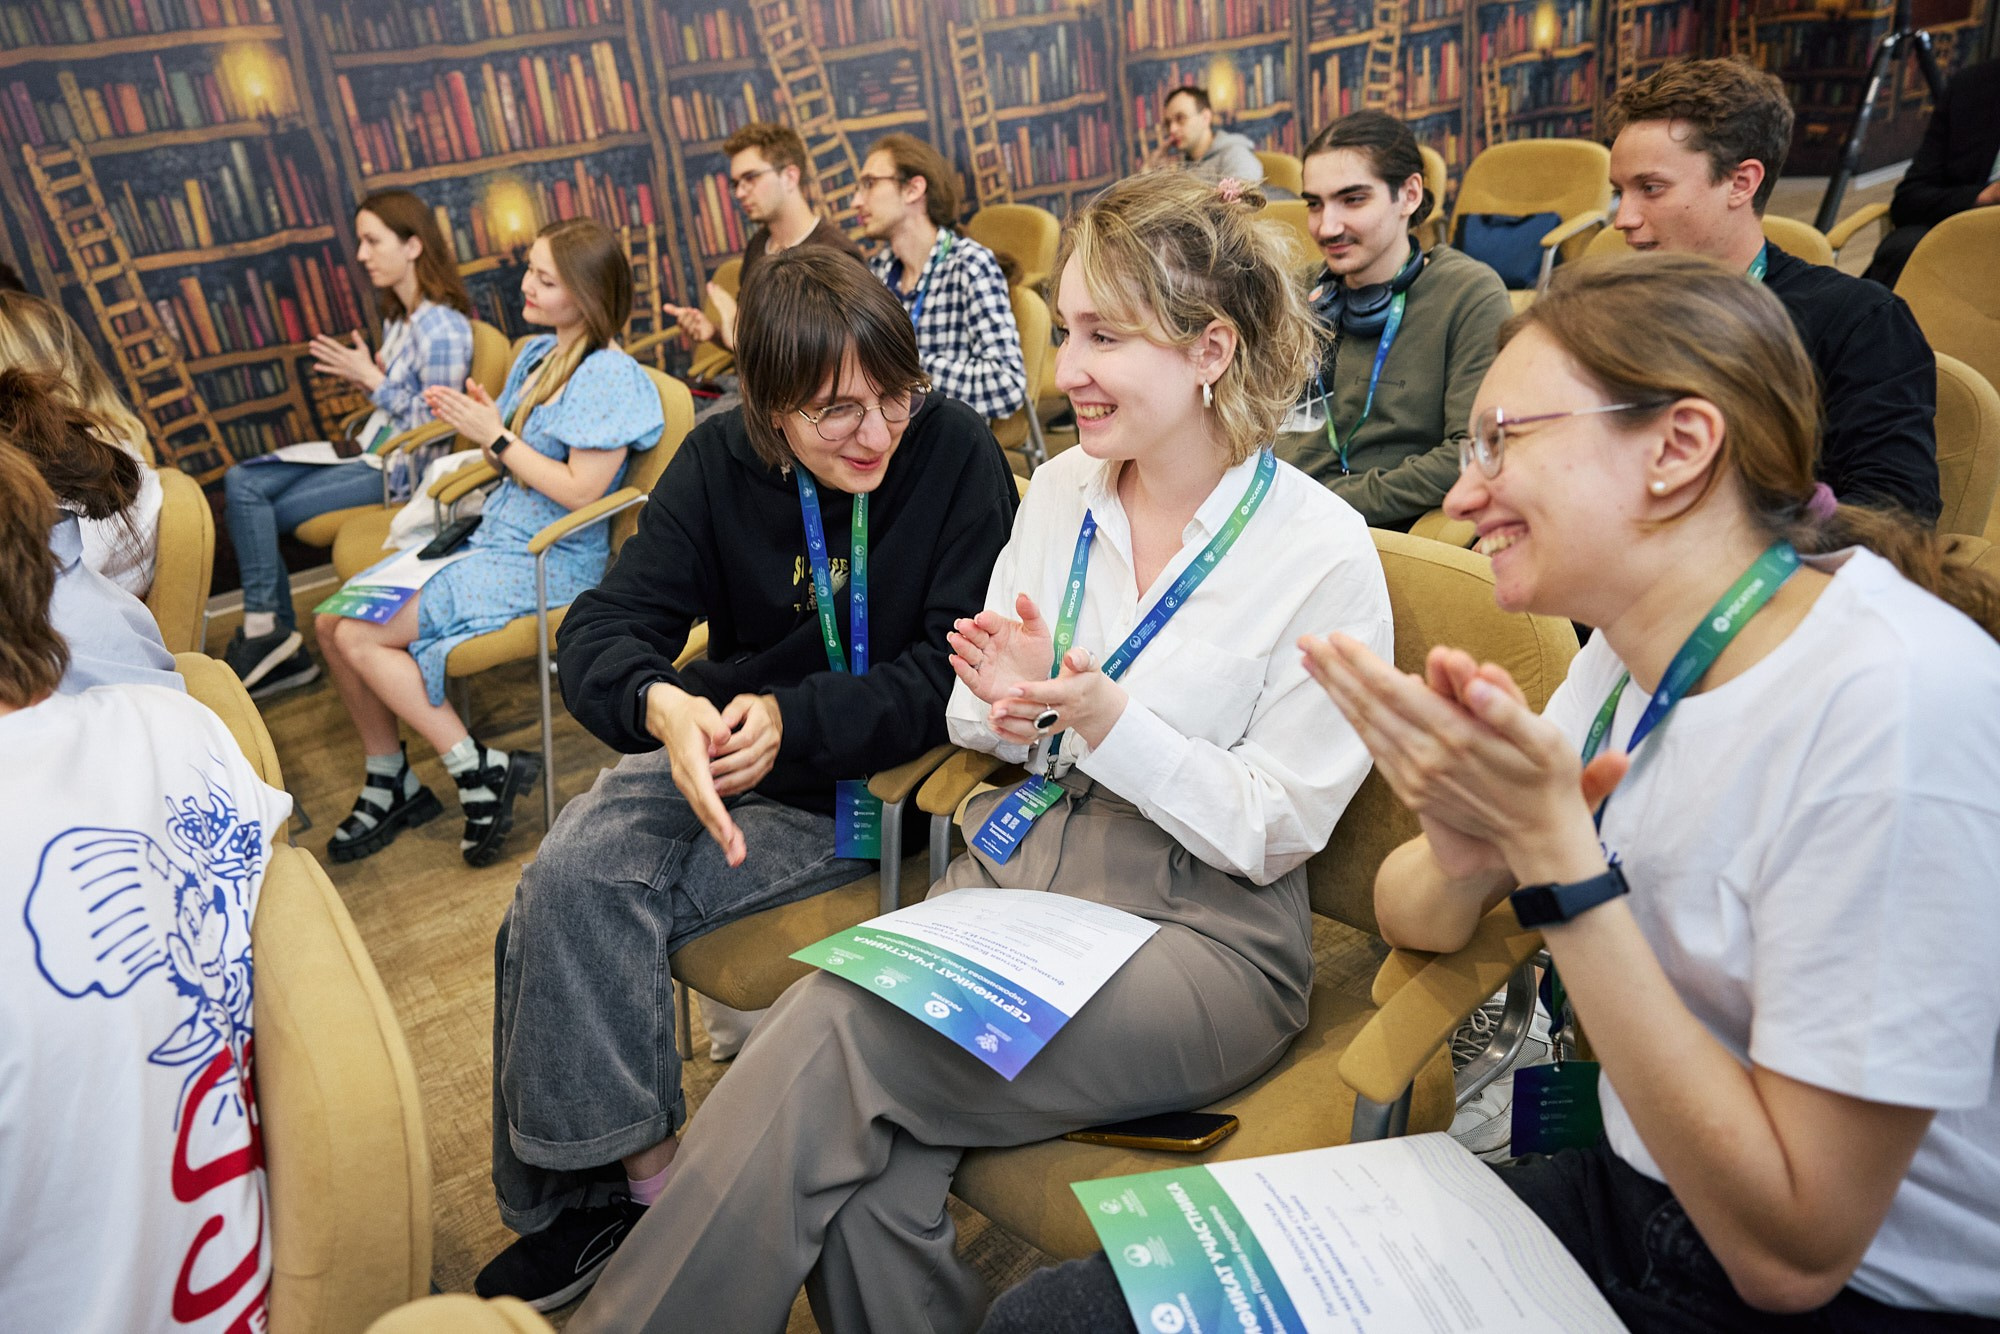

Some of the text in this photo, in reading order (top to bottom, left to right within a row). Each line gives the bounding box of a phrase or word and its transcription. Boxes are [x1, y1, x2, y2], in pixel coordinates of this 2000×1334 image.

[1247, 479, 1265, 507] РОСАТОМ
[1067, 588, 1078, 618] РОСАТОМ
[1723, 578, 1764, 620] РОСАТОМ
[825, 613, 836, 641] РОСАТОМ
[853, 935, 1031, 1023] СЕРТИФИКАТ УЧАСТНИКА
[940, 957, 968, 972] Алиса
[930, 991, 963, 1012] РОСАТОМ
[968, 970, 1027, 1006] Пирожникова
[1166, 1181, 1225, 1264] УЧАСТНИКА
